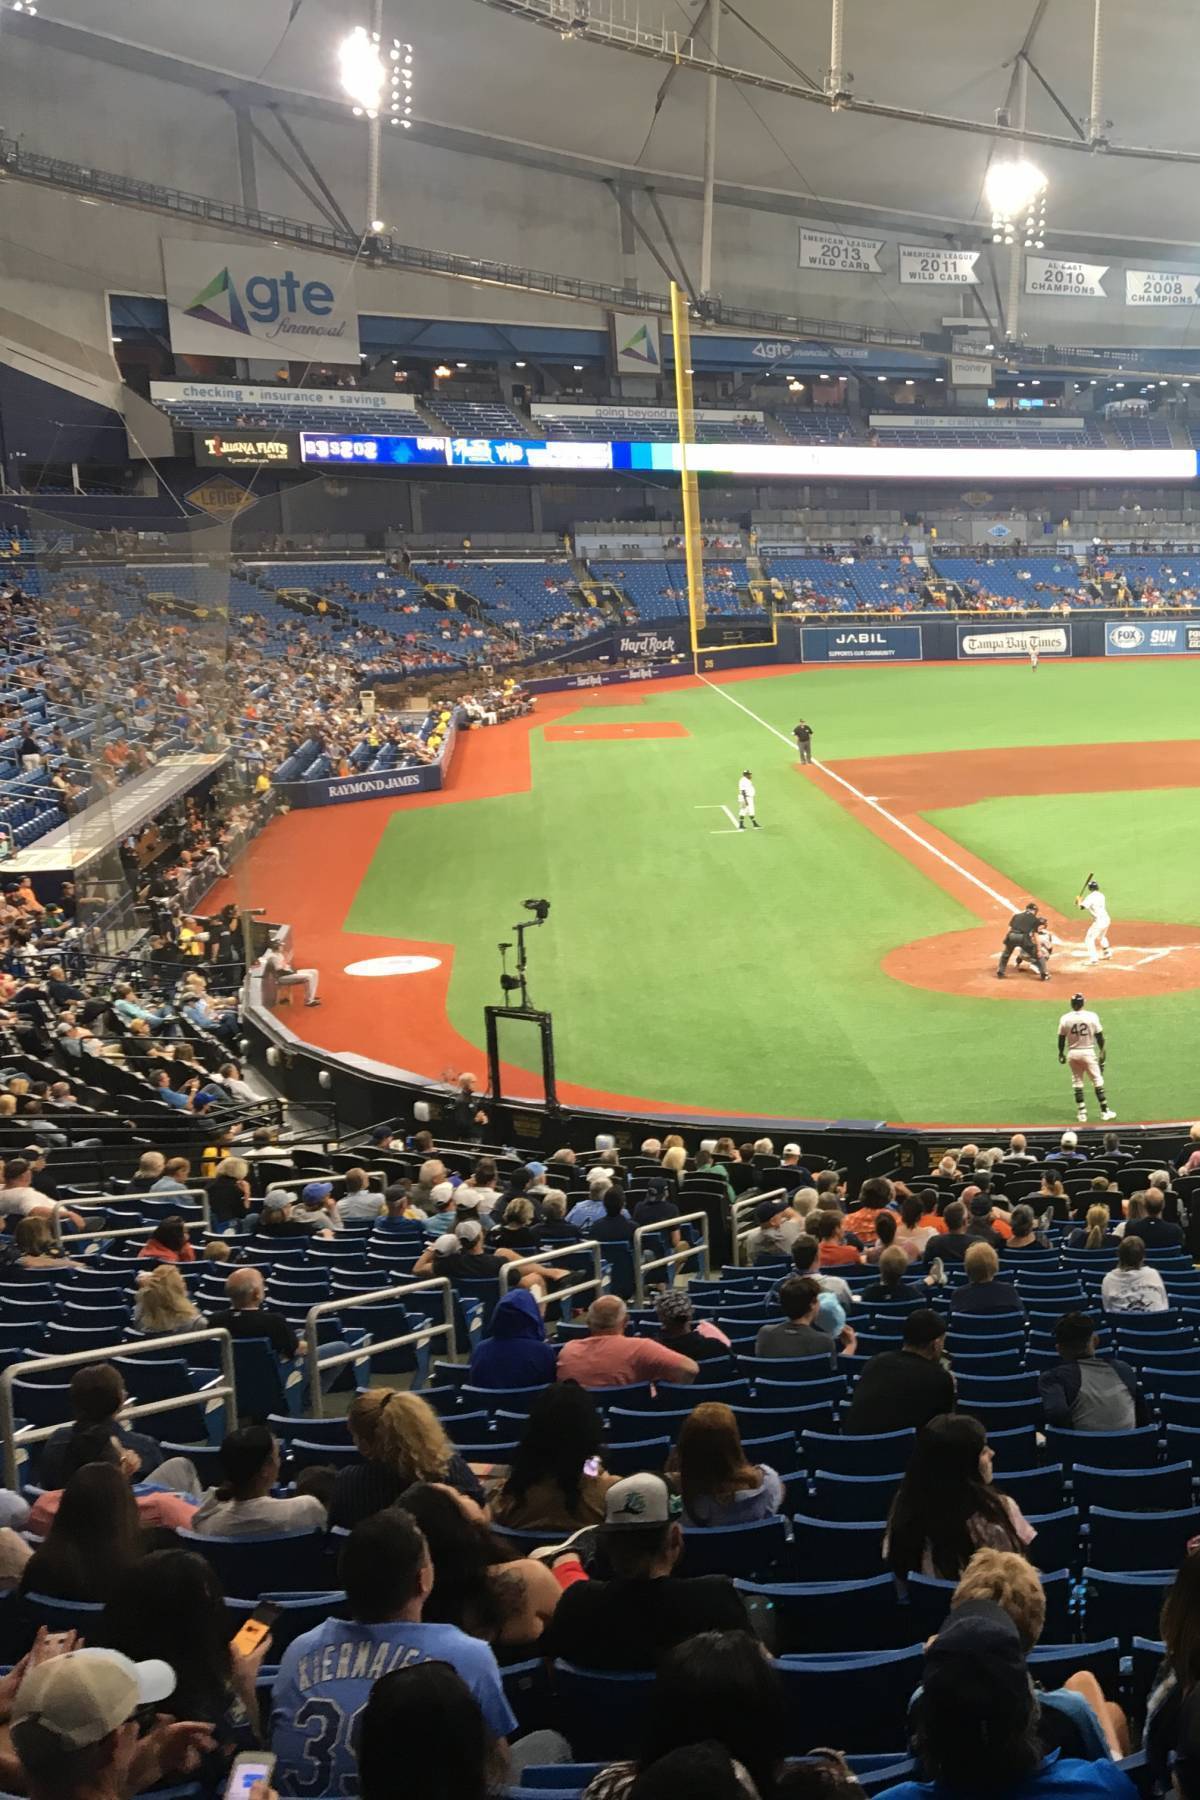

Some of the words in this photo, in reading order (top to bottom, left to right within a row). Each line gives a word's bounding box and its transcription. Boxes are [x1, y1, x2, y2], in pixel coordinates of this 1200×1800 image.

[803, 234, 844, 245] AMERICAN
[846, 239, 876, 250] LEAGUE
[821, 244, 861, 261] 2013
[902, 250, 941, 260] AMERICAN
[944, 252, 973, 260] LEAGUE
[809, 255, 836, 267] WILD
[841, 260, 870, 271] CARD
[920, 259, 958, 273] 2011
[1048, 262, 1059, 270] AL
[908, 271, 935, 281] WILD
[940, 273, 968, 282] CARD
[1043, 270, 1085, 285] 2010
[1146, 273, 1157, 281] AL
[1031, 282, 1096, 295] CHAMPIONS
[1143, 282, 1183, 295] 2008
[245, 270, 335, 323] gte
[1131, 294, 1193, 305] CHAMPIONS
[265, 317, 346, 338] financial
[766, 343, 792, 358] gte
[955, 362, 986, 375] money
[183, 385, 244, 402] checking
[260, 390, 323, 404] insurance
[339, 393, 387, 407] savings
[595, 407, 625, 420] going
[627, 408, 667, 420] beyond
[835, 633, 888, 644] JABIL
[1117, 630, 1137, 640] FOX
[1150, 629, 1177, 643] SUN
[620, 637, 649, 652] Hard
[649, 636, 676, 653] Rock
[968, 638, 1004, 651] Tampa
[1006, 637, 1028, 650] Bay
[1028, 636, 1063, 649] Times
[328, 779, 385, 798] RAYMOND
[384, 774, 420, 789] JAMES
[1070, 1022, 1089, 1037] 42
